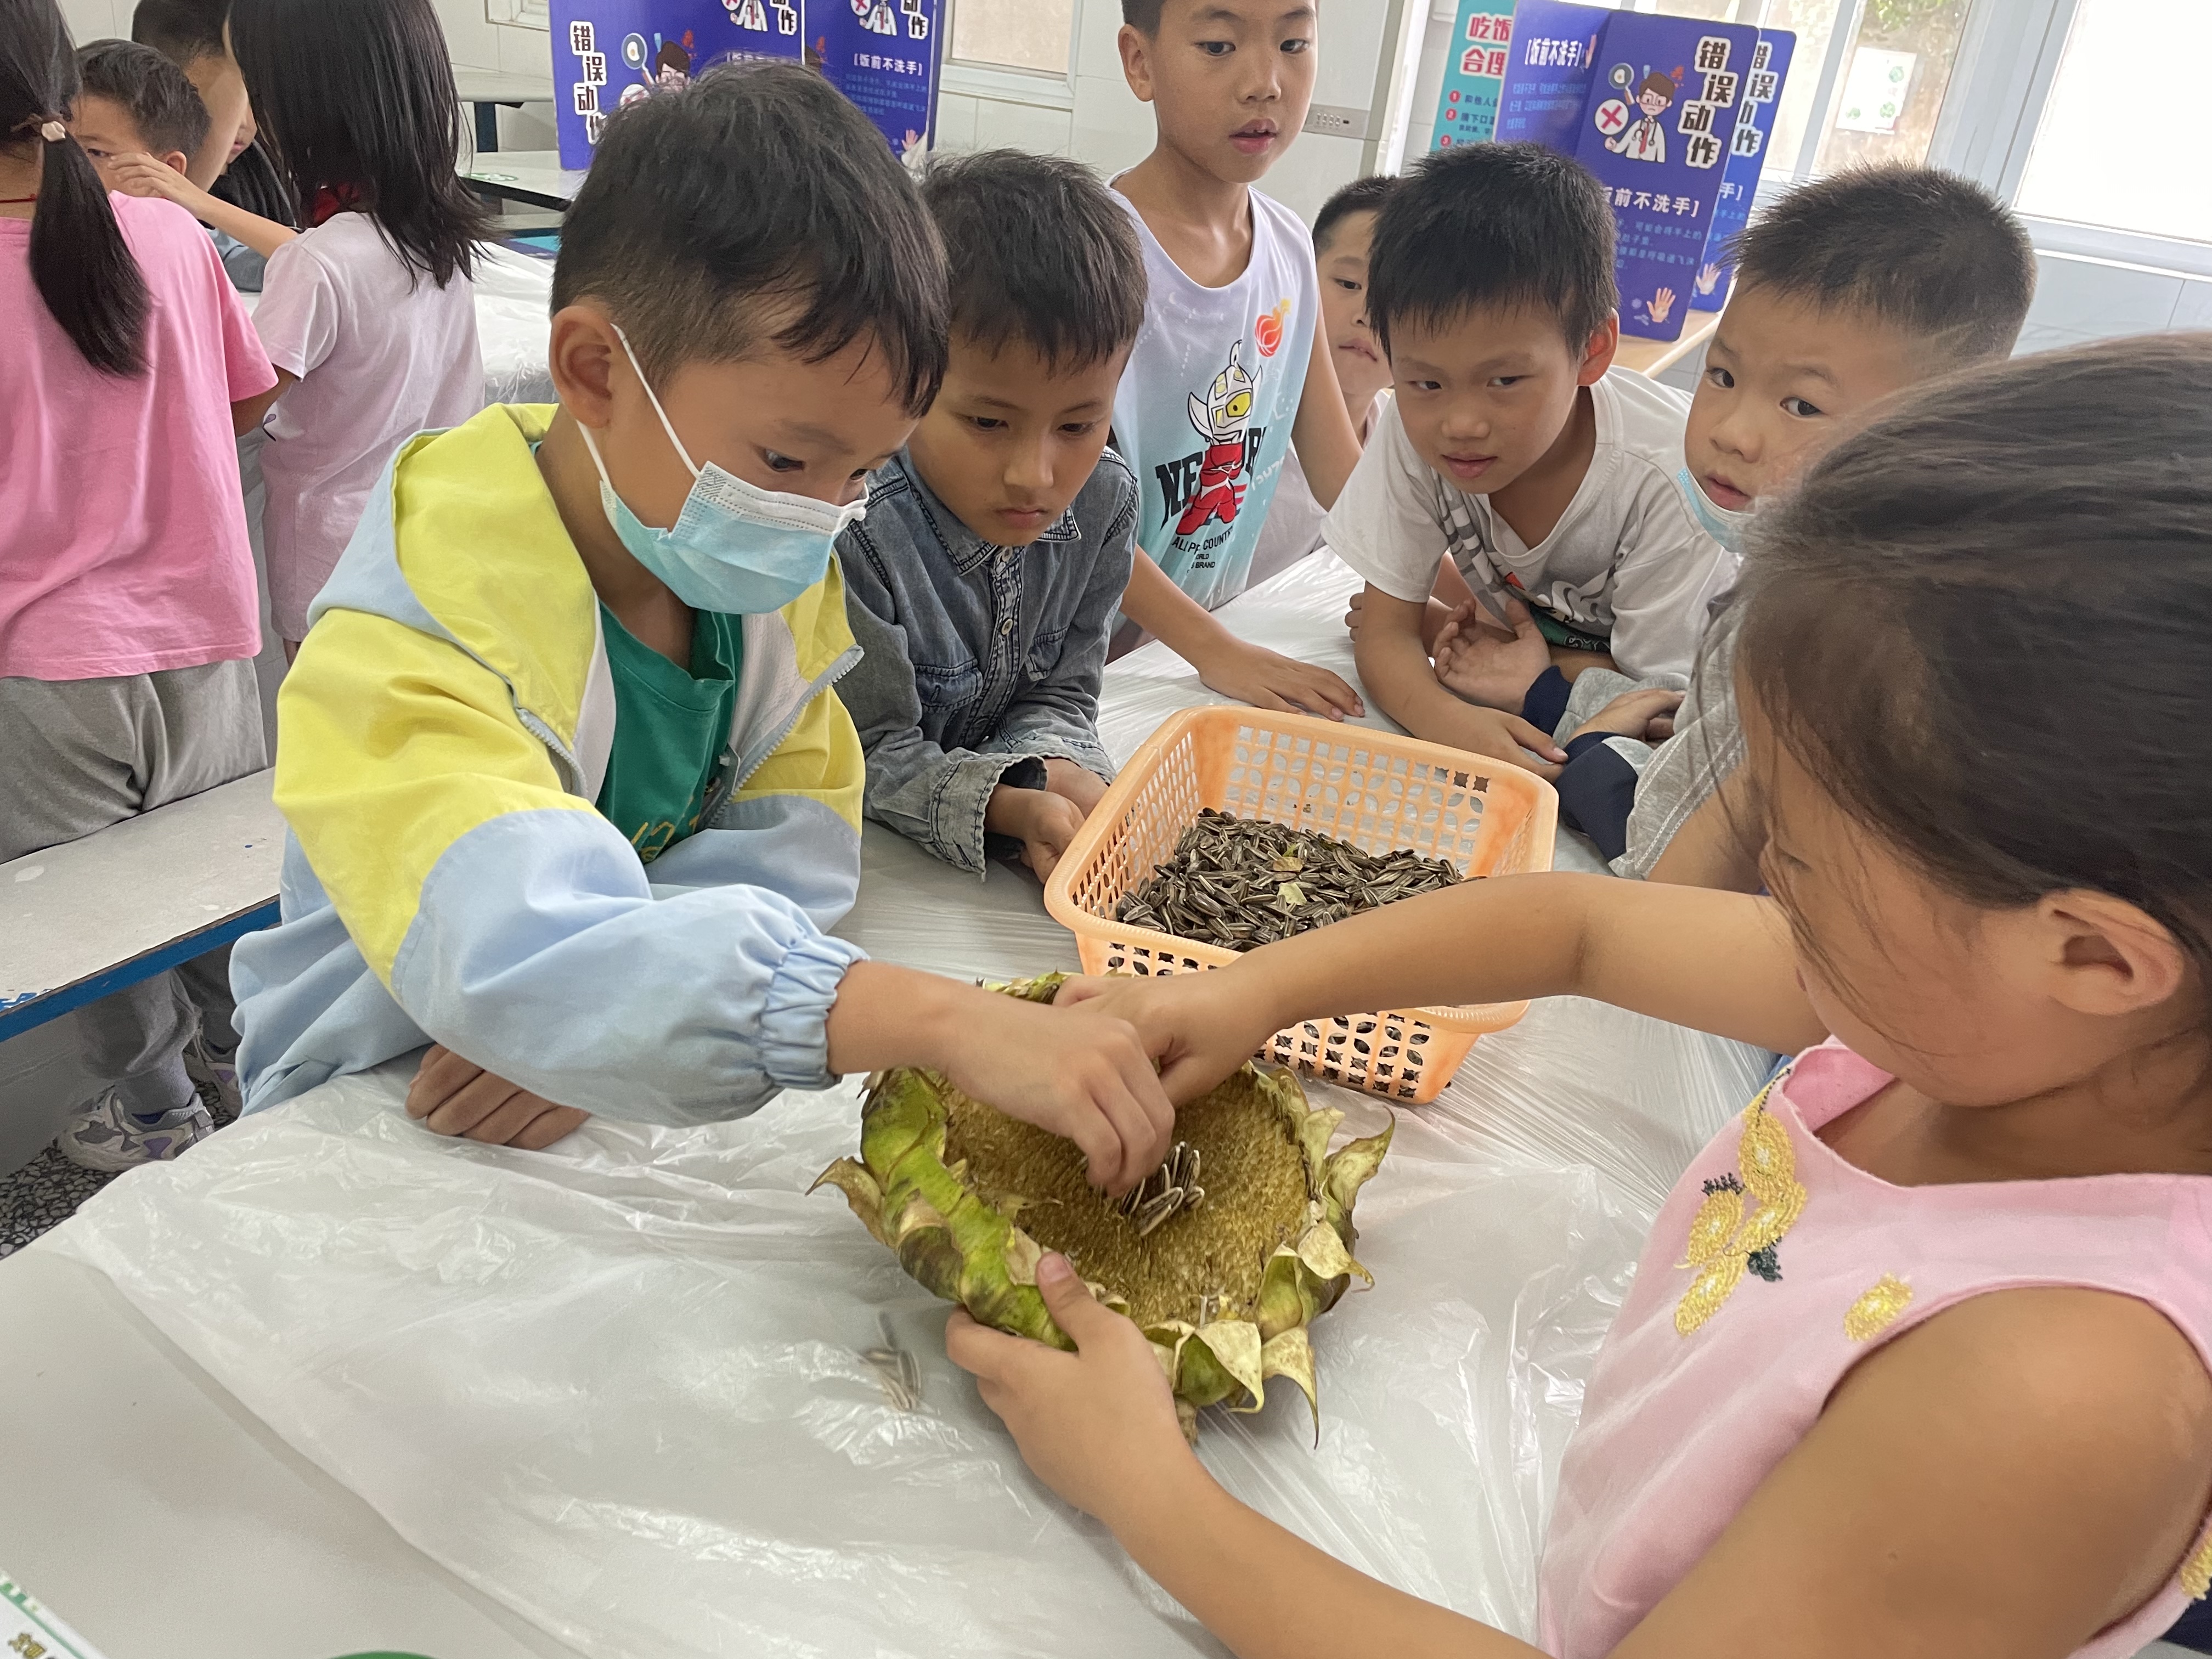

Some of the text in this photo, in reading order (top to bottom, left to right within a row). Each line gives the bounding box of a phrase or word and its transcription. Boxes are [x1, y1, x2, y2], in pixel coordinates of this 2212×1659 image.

[1469, 16, 1512, 42] 吃饭
[1682, 41, 1734, 163] 错误动作
